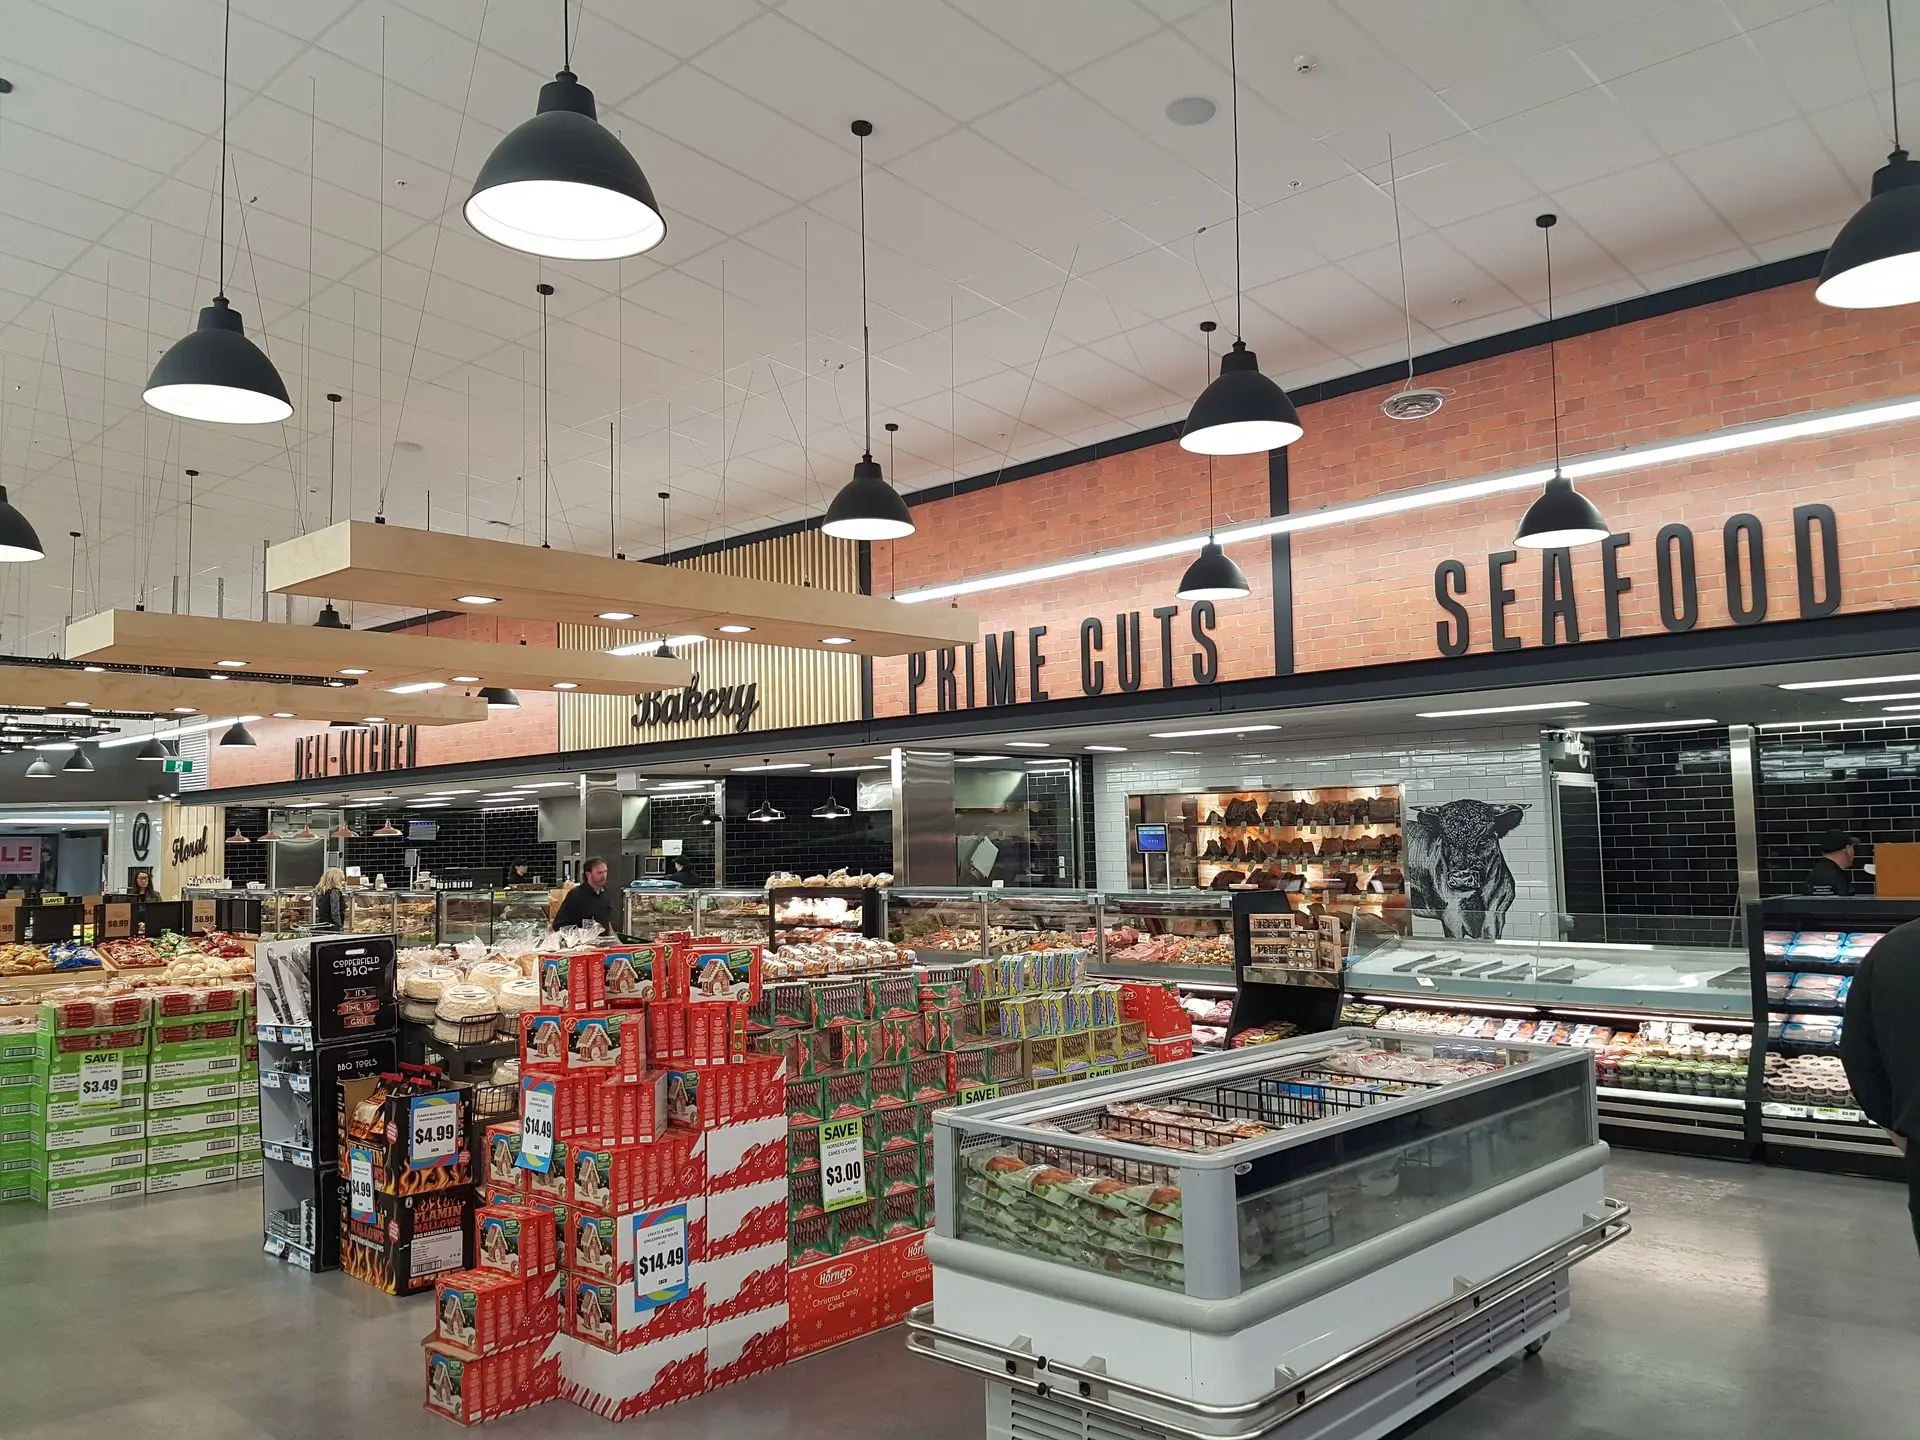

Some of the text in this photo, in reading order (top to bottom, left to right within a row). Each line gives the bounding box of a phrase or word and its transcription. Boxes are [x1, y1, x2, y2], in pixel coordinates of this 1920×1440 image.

[1434, 504, 1842, 657] SEAFOOD
[908, 600, 1218, 714] PRIME CUTS
[631, 672, 760, 732] Bakery
[172, 824, 208, 867] Floral
[107, 919, 129, 928] $6.99
[332, 956, 380, 968] COPPERFIELD
[346, 965, 368, 977] BBQ
[355, 988, 367, 997] IT'S
[346, 1002, 372, 1012] TIME TO
[350, 1017, 369, 1026] GRILL
[84, 1052, 119, 1064] SAVE!
[337, 1058, 378, 1072] BBQ TOOLS
[82, 1078, 118, 1094] $3.49
[965, 1088, 995, 1104] SAVE!
[414, 1124, 454, 1145] $4.99
[525, 1116, 552, 1138] $14.49
[824, 1121, 858, 1141] SAVE!
[826, 1141, 845, 1150] HORNERS
[826, 1161, 861, 1187] $3.00
[352, 1178, 371, 1198] $4.99
[414, 1217, 461, 1233] MALLOWS
[423, 1225, 462, 1237] MARSHMALLOWS
[639, 1247, 684, 1276] $14.49
[819, 1265, 853, 1286] Horners
[901, 1266, 927, 1279] Christmas
[915, 1273, 931, 1283] Canes
[812, 1286, 860, 1308] Christmas Candy
[827, 1300, 845, 1312] Canes
